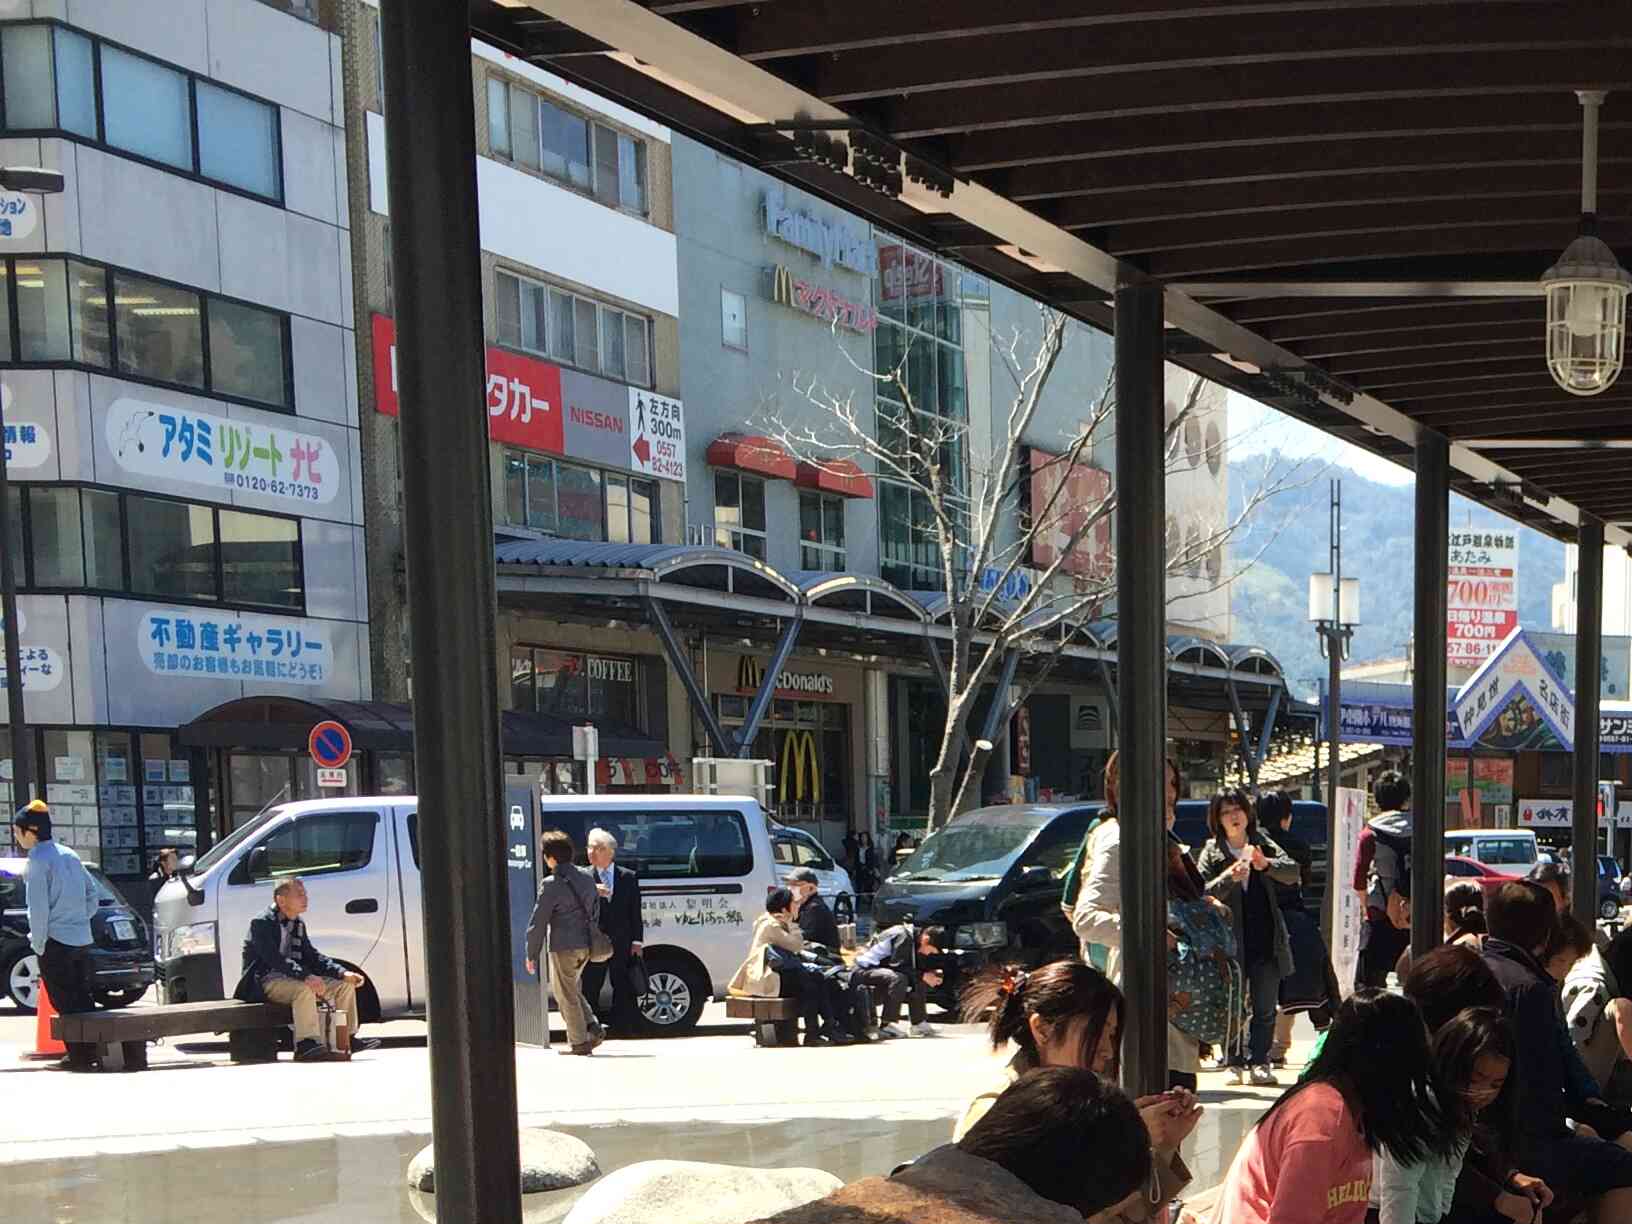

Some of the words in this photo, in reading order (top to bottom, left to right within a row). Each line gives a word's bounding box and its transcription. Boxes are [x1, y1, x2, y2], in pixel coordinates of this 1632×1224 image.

[569, 406, 624, 433] NISSAN
[650, 398, 681, 422] 左方向
[650, 418, 682, 441] 300m
[656, 440, 677, 458] 0557
[150, 617, 322, 658] 不動産ギャラリー
[1454, 623, 1496, 639] 700円
[587, 657, 633, 682] COFFEE
